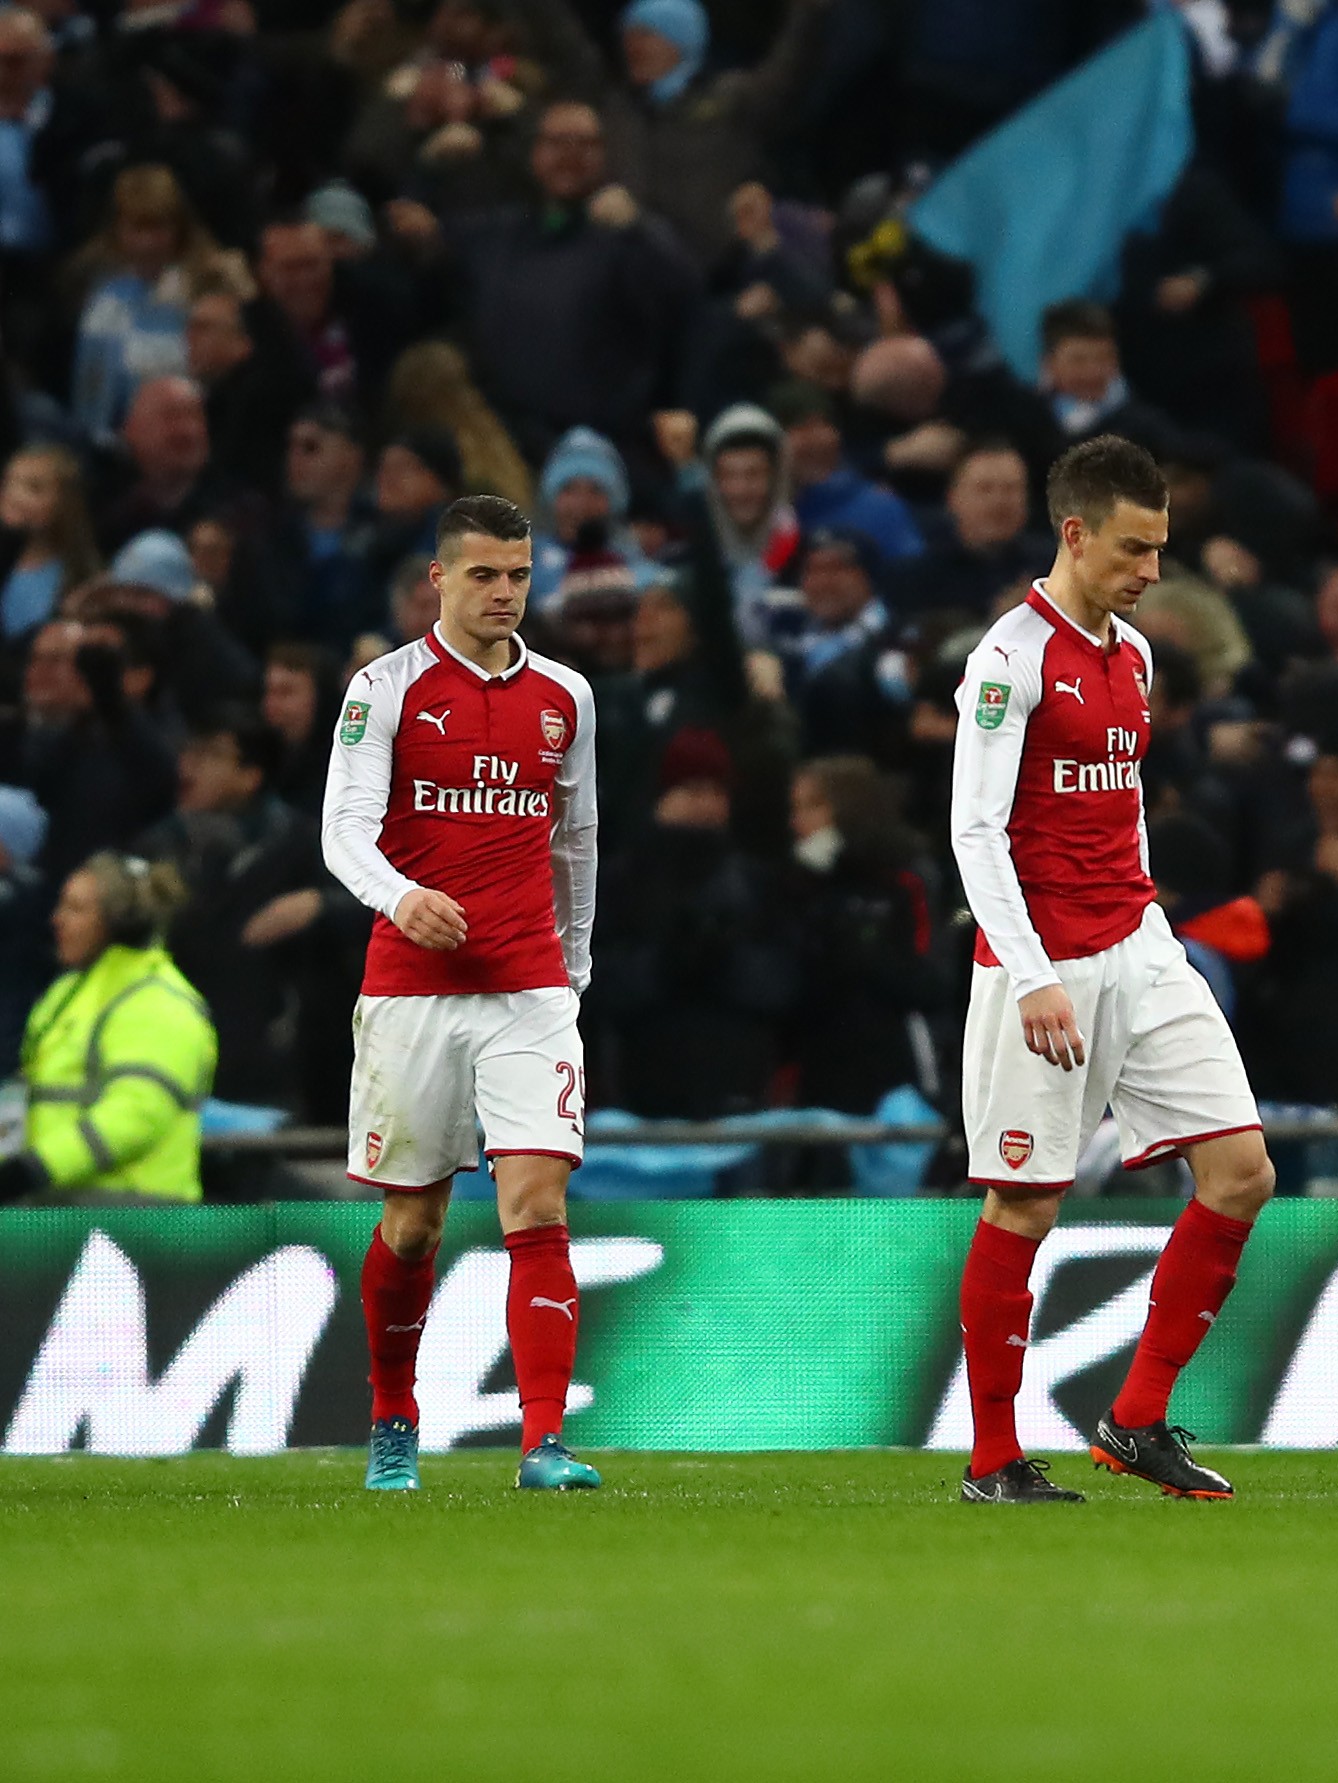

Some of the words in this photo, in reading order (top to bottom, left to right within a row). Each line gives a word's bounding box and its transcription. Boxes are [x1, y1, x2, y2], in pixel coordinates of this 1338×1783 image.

[1106, 726, 1137, 756] Fly
[473, 755, 519, 785] Fly
[413, 779, 549, 817] Emirates
